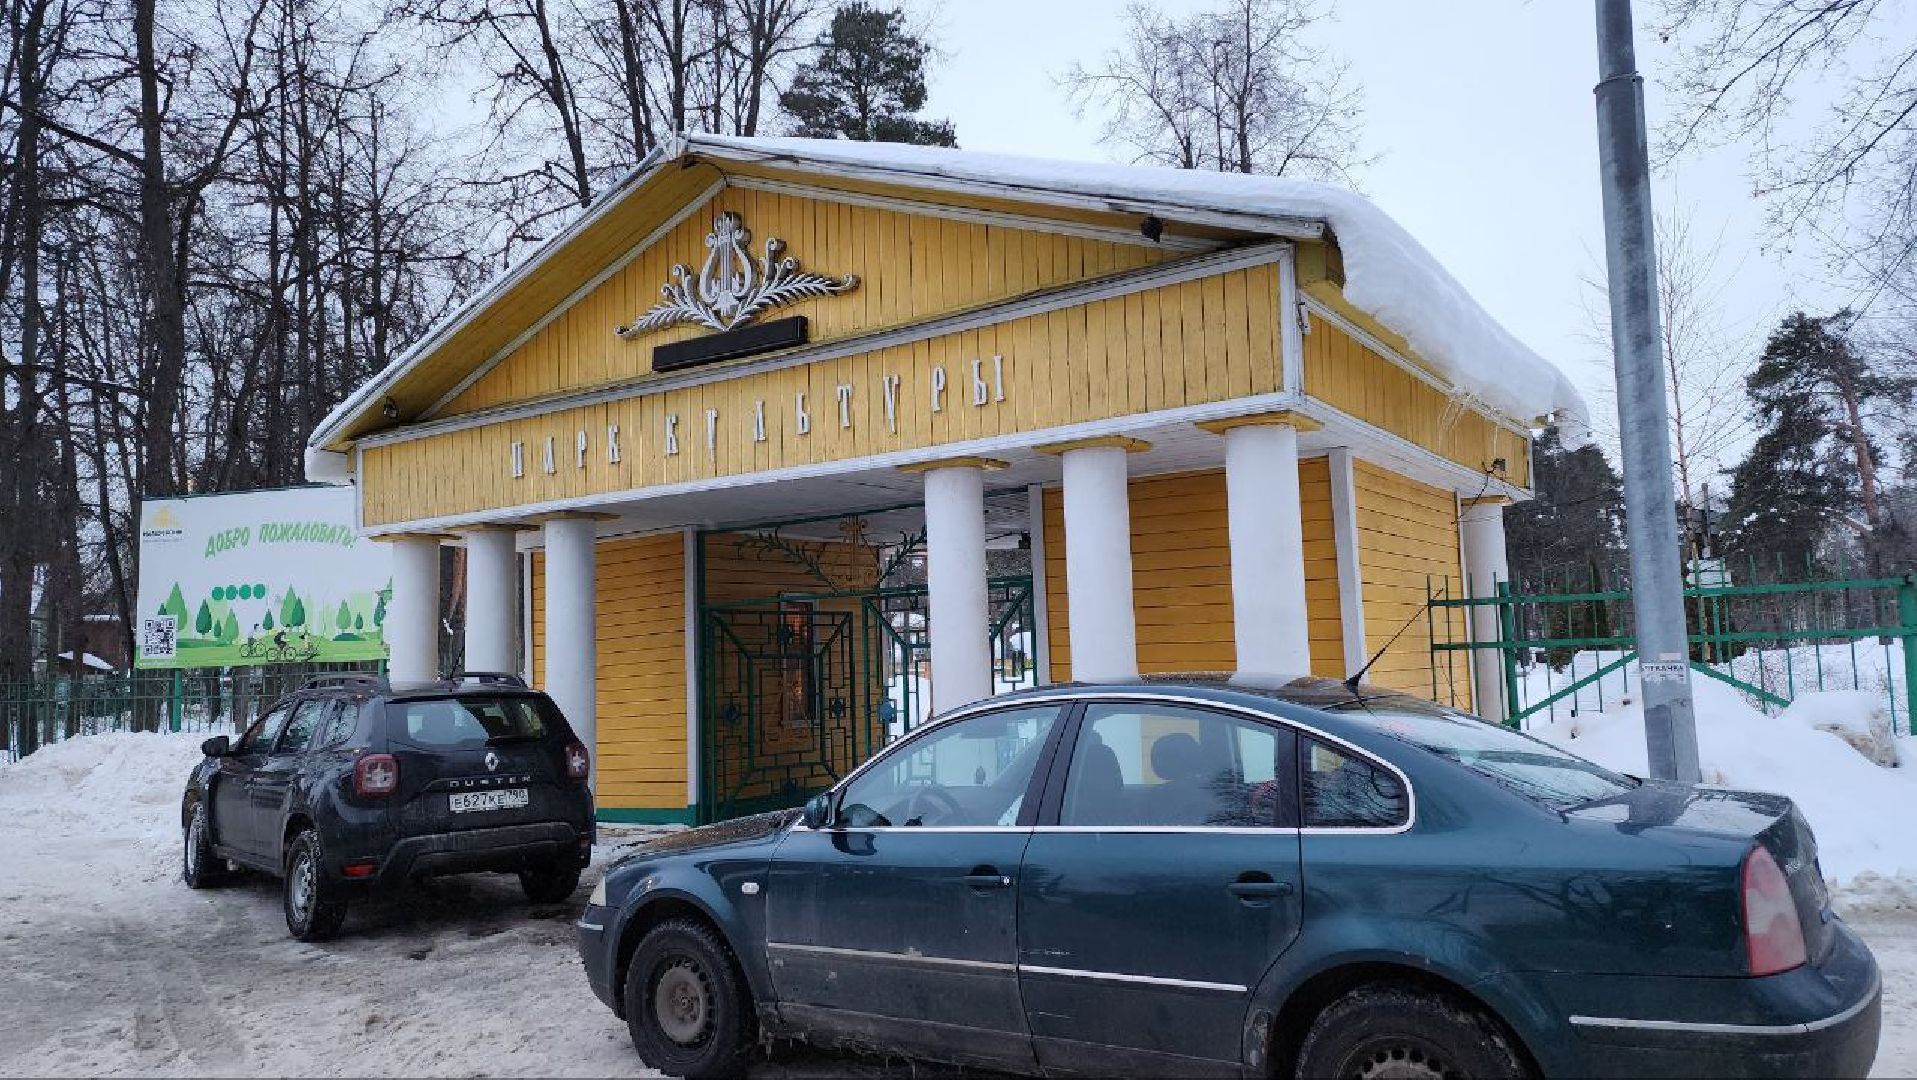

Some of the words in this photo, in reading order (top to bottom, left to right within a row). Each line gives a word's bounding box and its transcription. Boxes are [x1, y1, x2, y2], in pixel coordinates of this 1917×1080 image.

[511, 422, 622, 480] ПАРК
[665, 352, 1006, 463] КУЛЬТУРЫ
[204, 526, 250, 559] ДОБРО
[259, 521, 357, 549] ПОЖАЛОВАТЬ!
